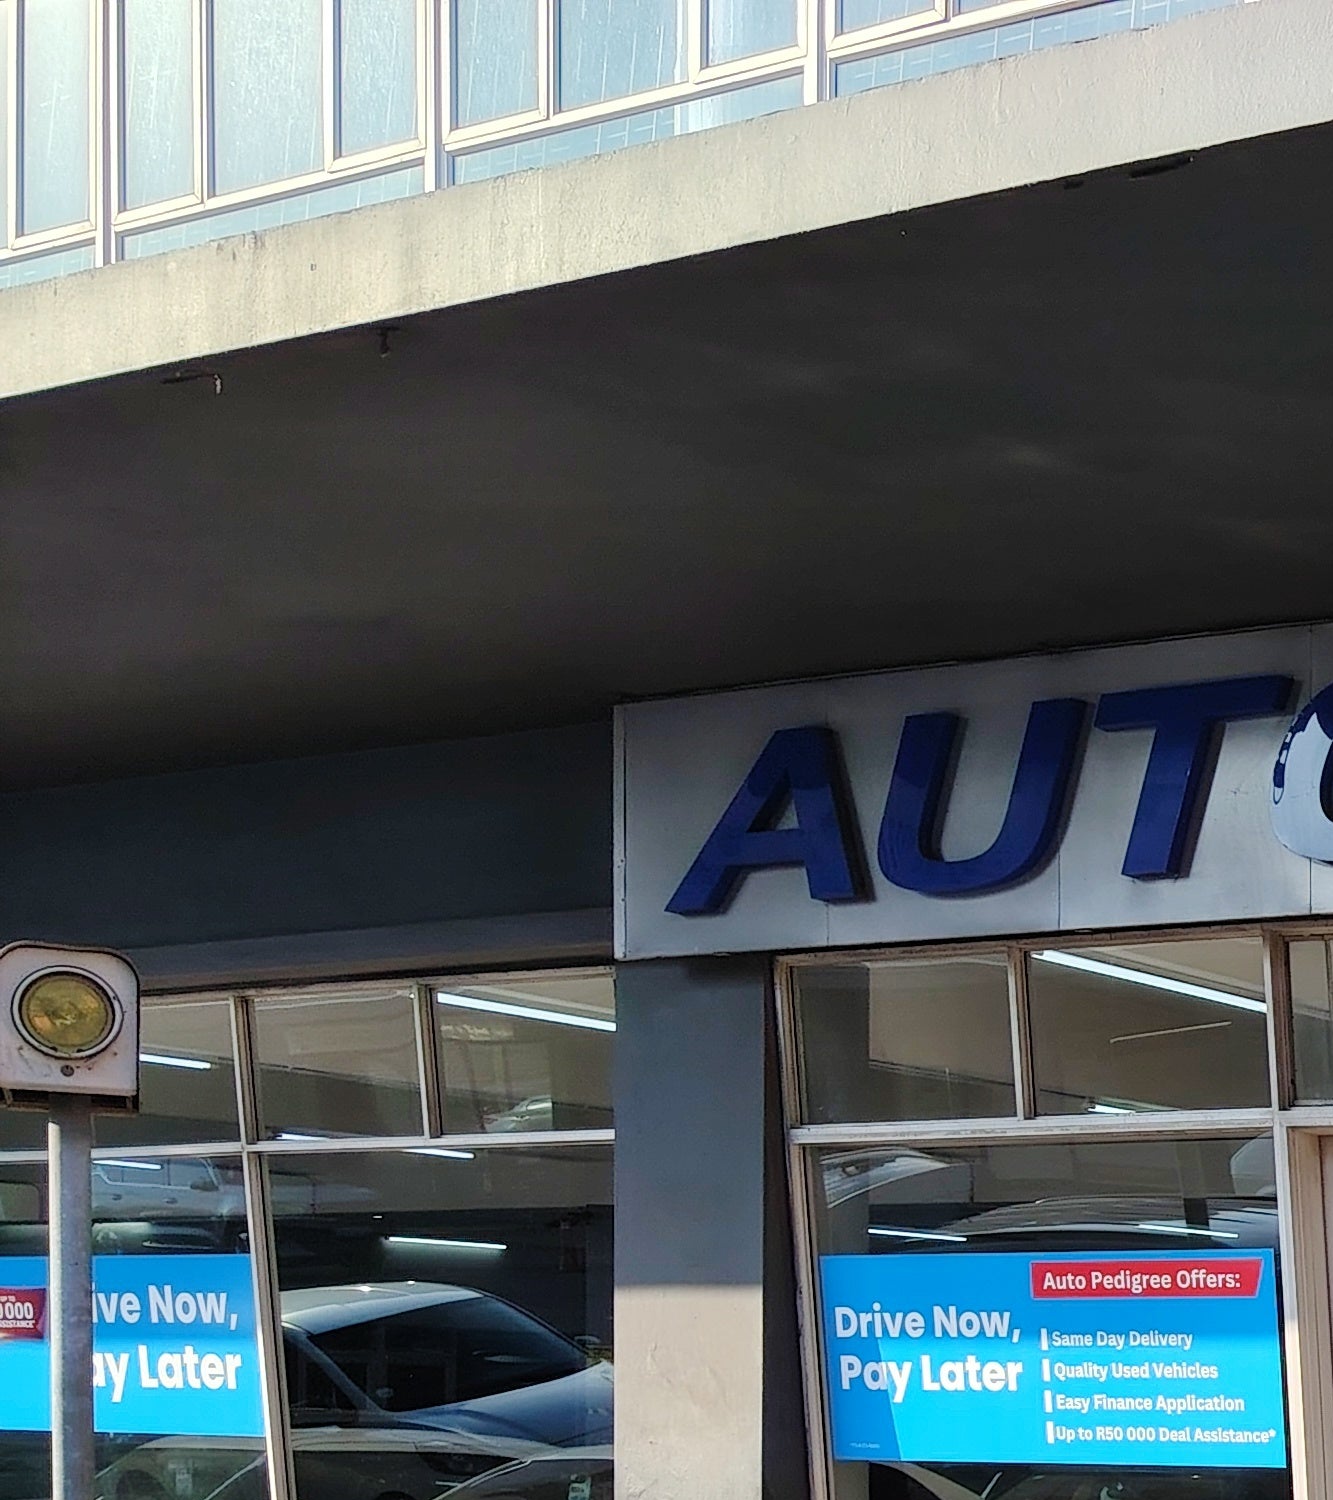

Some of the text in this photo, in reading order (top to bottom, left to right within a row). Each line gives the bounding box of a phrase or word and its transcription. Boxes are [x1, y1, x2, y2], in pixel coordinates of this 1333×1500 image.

[1043, 1268, 1241, 1294] Auto Pedigree Offers:
[91, 1282, 238, 1330] ive Now,
[834, 1302, 1021, 1343] Drive Now,
[1051, 1330, 1193, 1350] Same Day Delivery
[138, 1345, 242, 1390] Later
[840, 1355, 1023, 1404] Pay Later
[1054, 1362, 1219, 1382] Quality Used Vehicles
[1056, 1394, 1245, 1414] Easy Finance Application
[1055, 1426, 1075, 1444] Up
[1077, 1427, 1093, 1441] to
[1096, 1427, 1123, 1441] R50
[1126, 1427, 1156, 1442] 000
[1159, 1427, 1191, 1443] Deal
